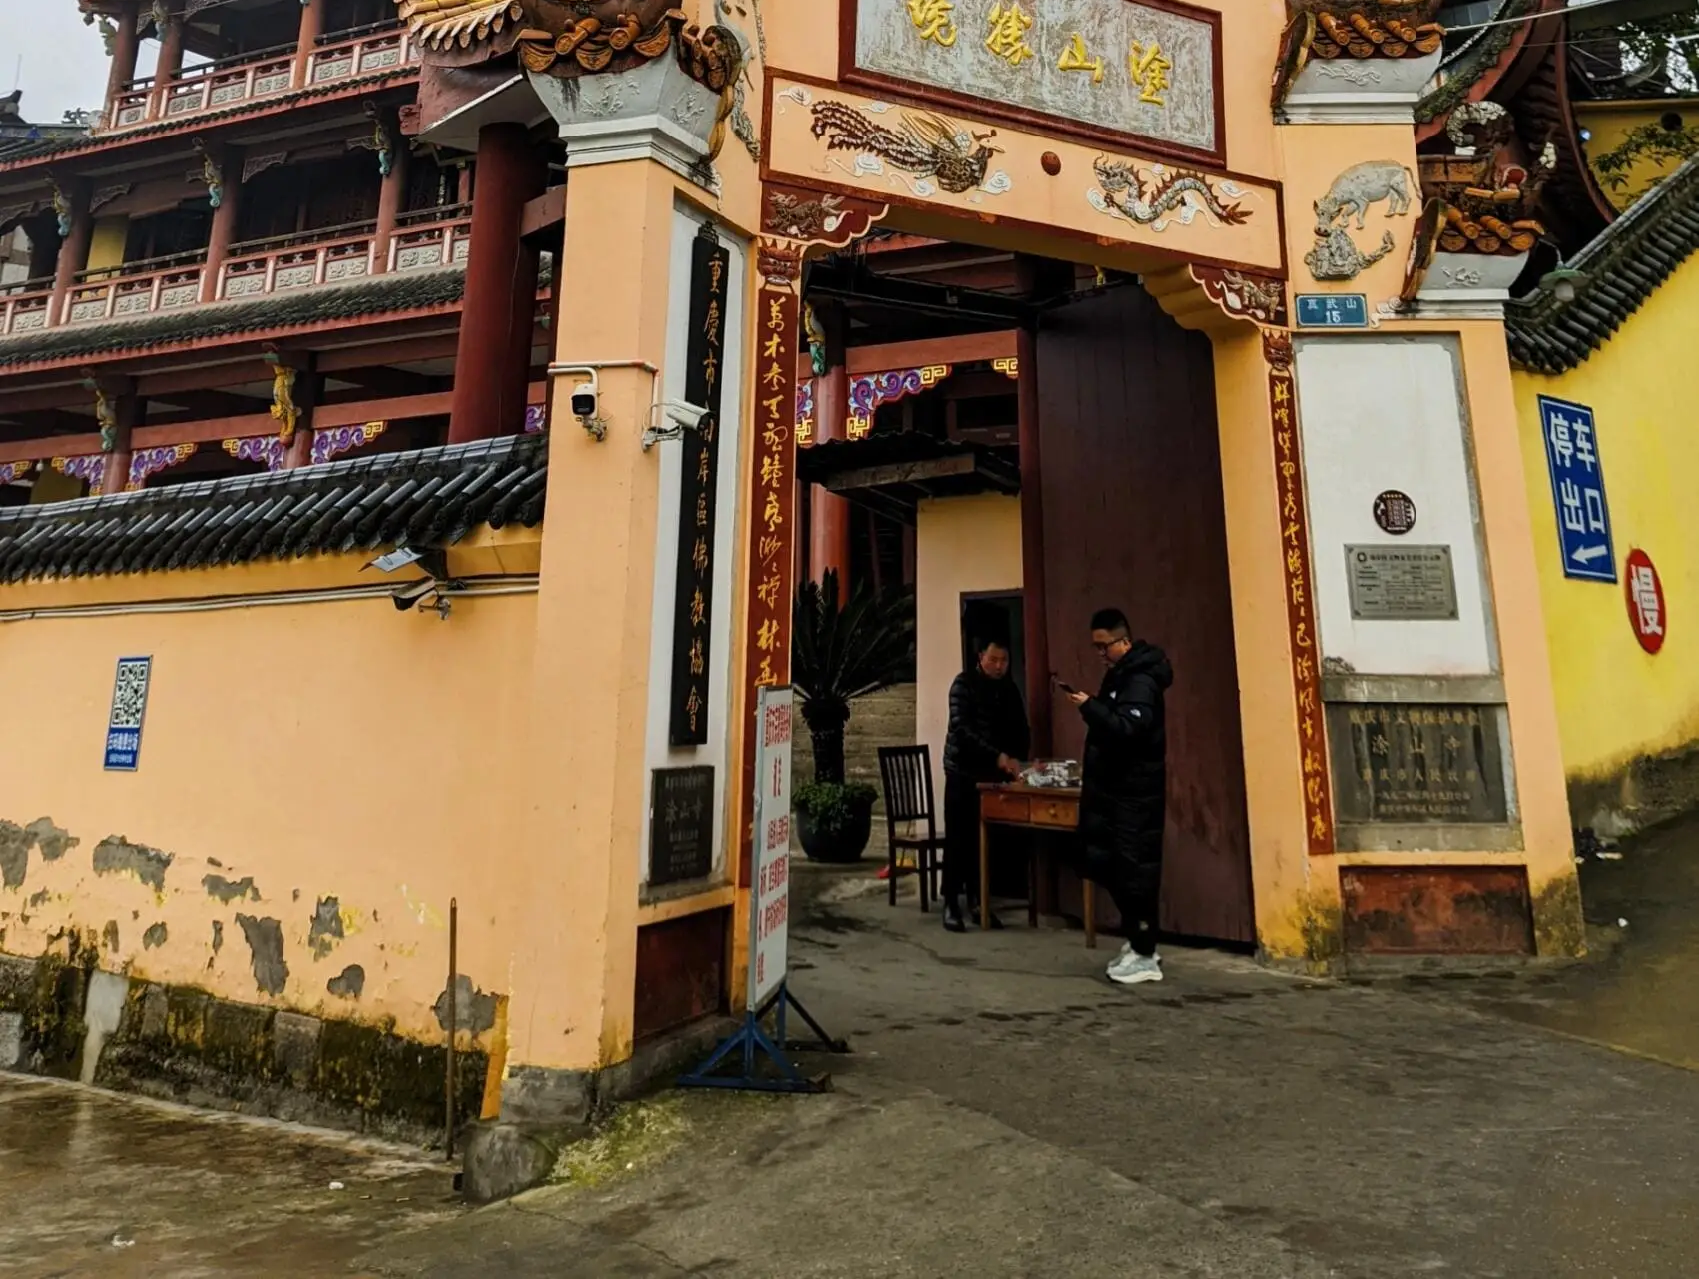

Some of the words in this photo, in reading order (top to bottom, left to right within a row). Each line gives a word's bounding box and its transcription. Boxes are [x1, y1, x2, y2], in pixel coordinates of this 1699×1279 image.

[1550, 411, 1597, 473] 停车
[1560, 477, 1607, 535] 出口
[1630, 563, 1663, 636] 慢
